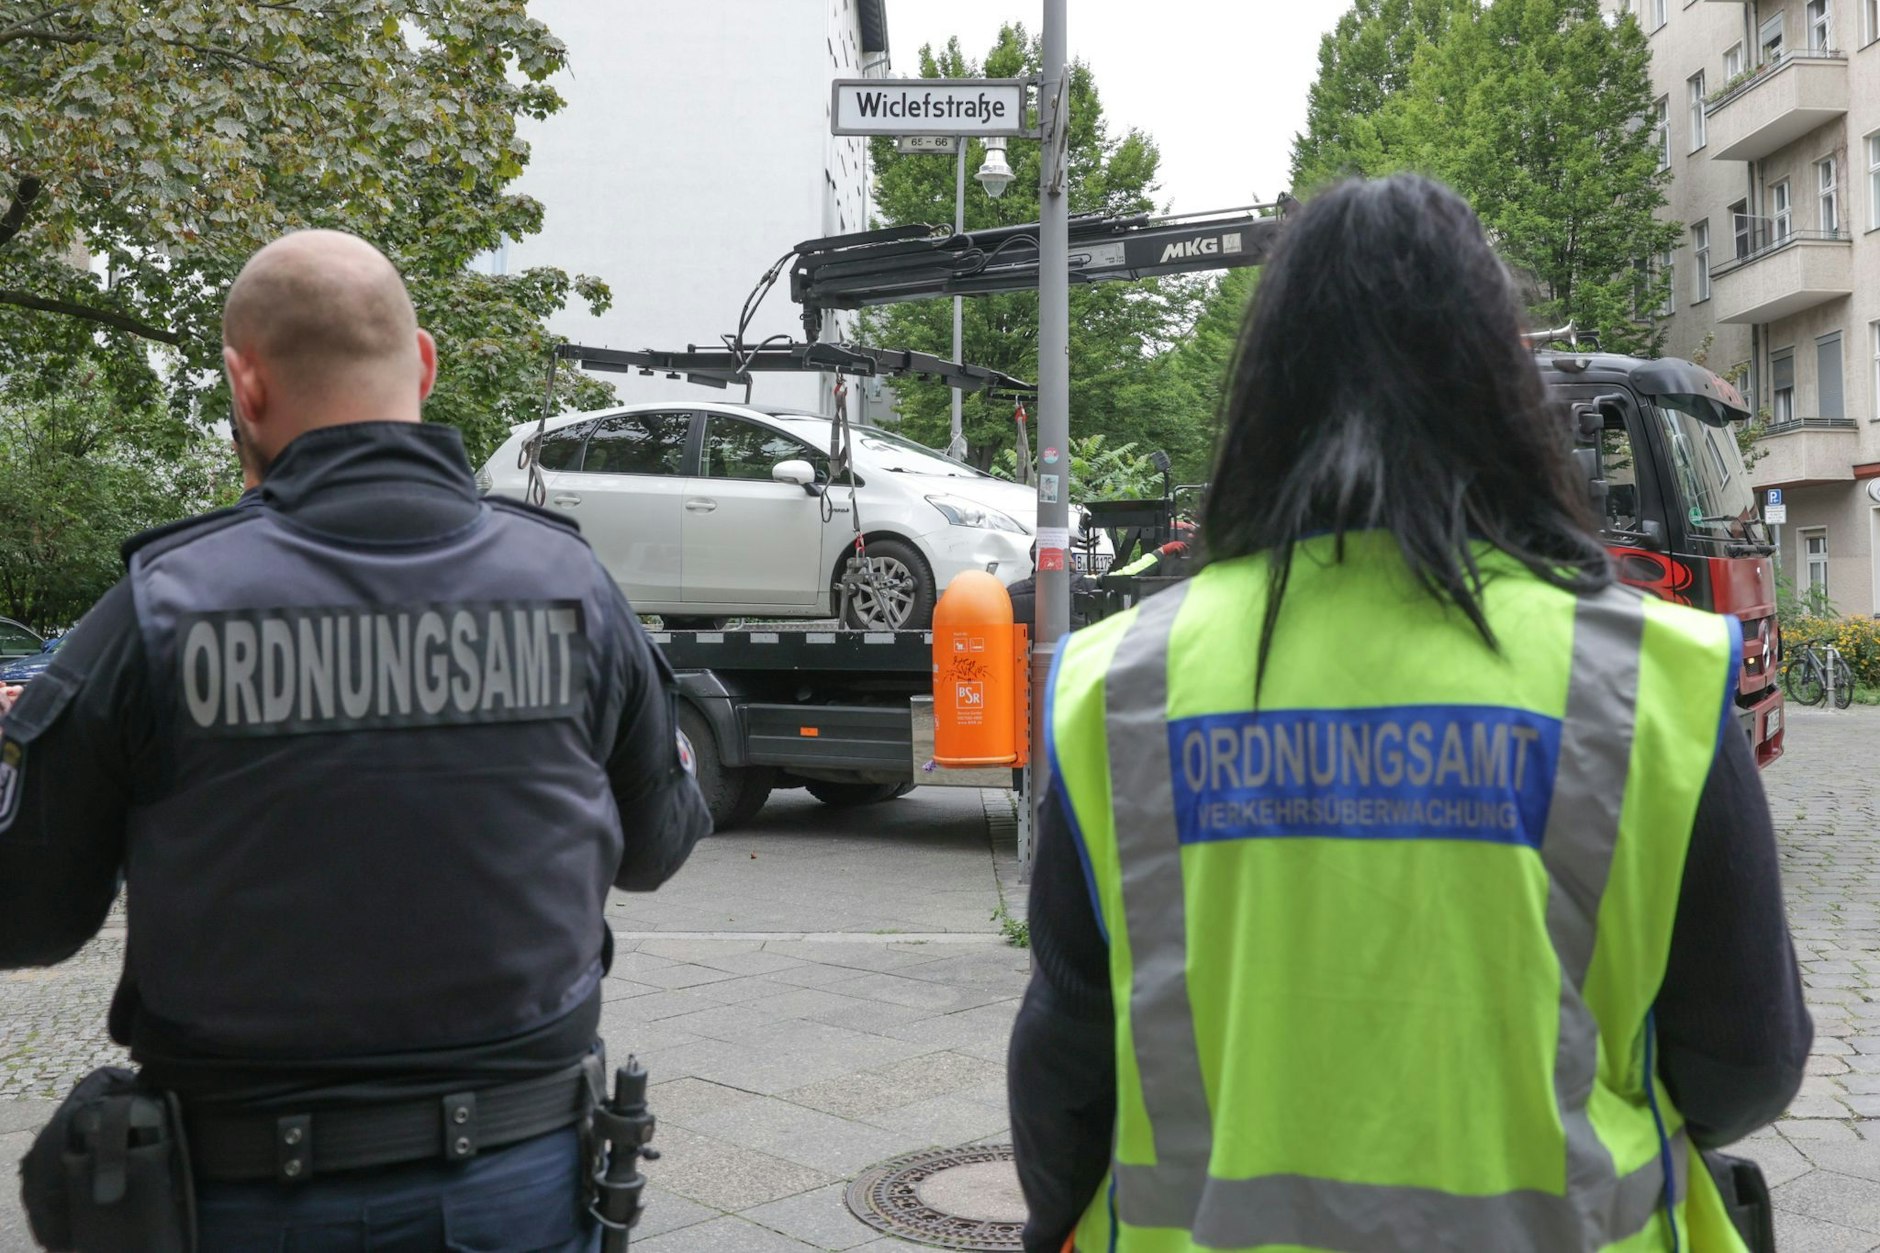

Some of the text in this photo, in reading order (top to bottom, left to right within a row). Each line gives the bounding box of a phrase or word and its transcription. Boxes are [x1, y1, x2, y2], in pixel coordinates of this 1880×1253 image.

[856, 92, 1005, 124] Wiclefstraße
[911, 138, 923, 147] 65
[935, 138, 948, 147] 66
[1159, 237, 1218, 263] MKG
[183, 609, 577, 728] ORDNUNGSAMT
[959, 687, 980, 704] BSR
[1182, 721, 1539, 792] ORDNUNGSAMT
